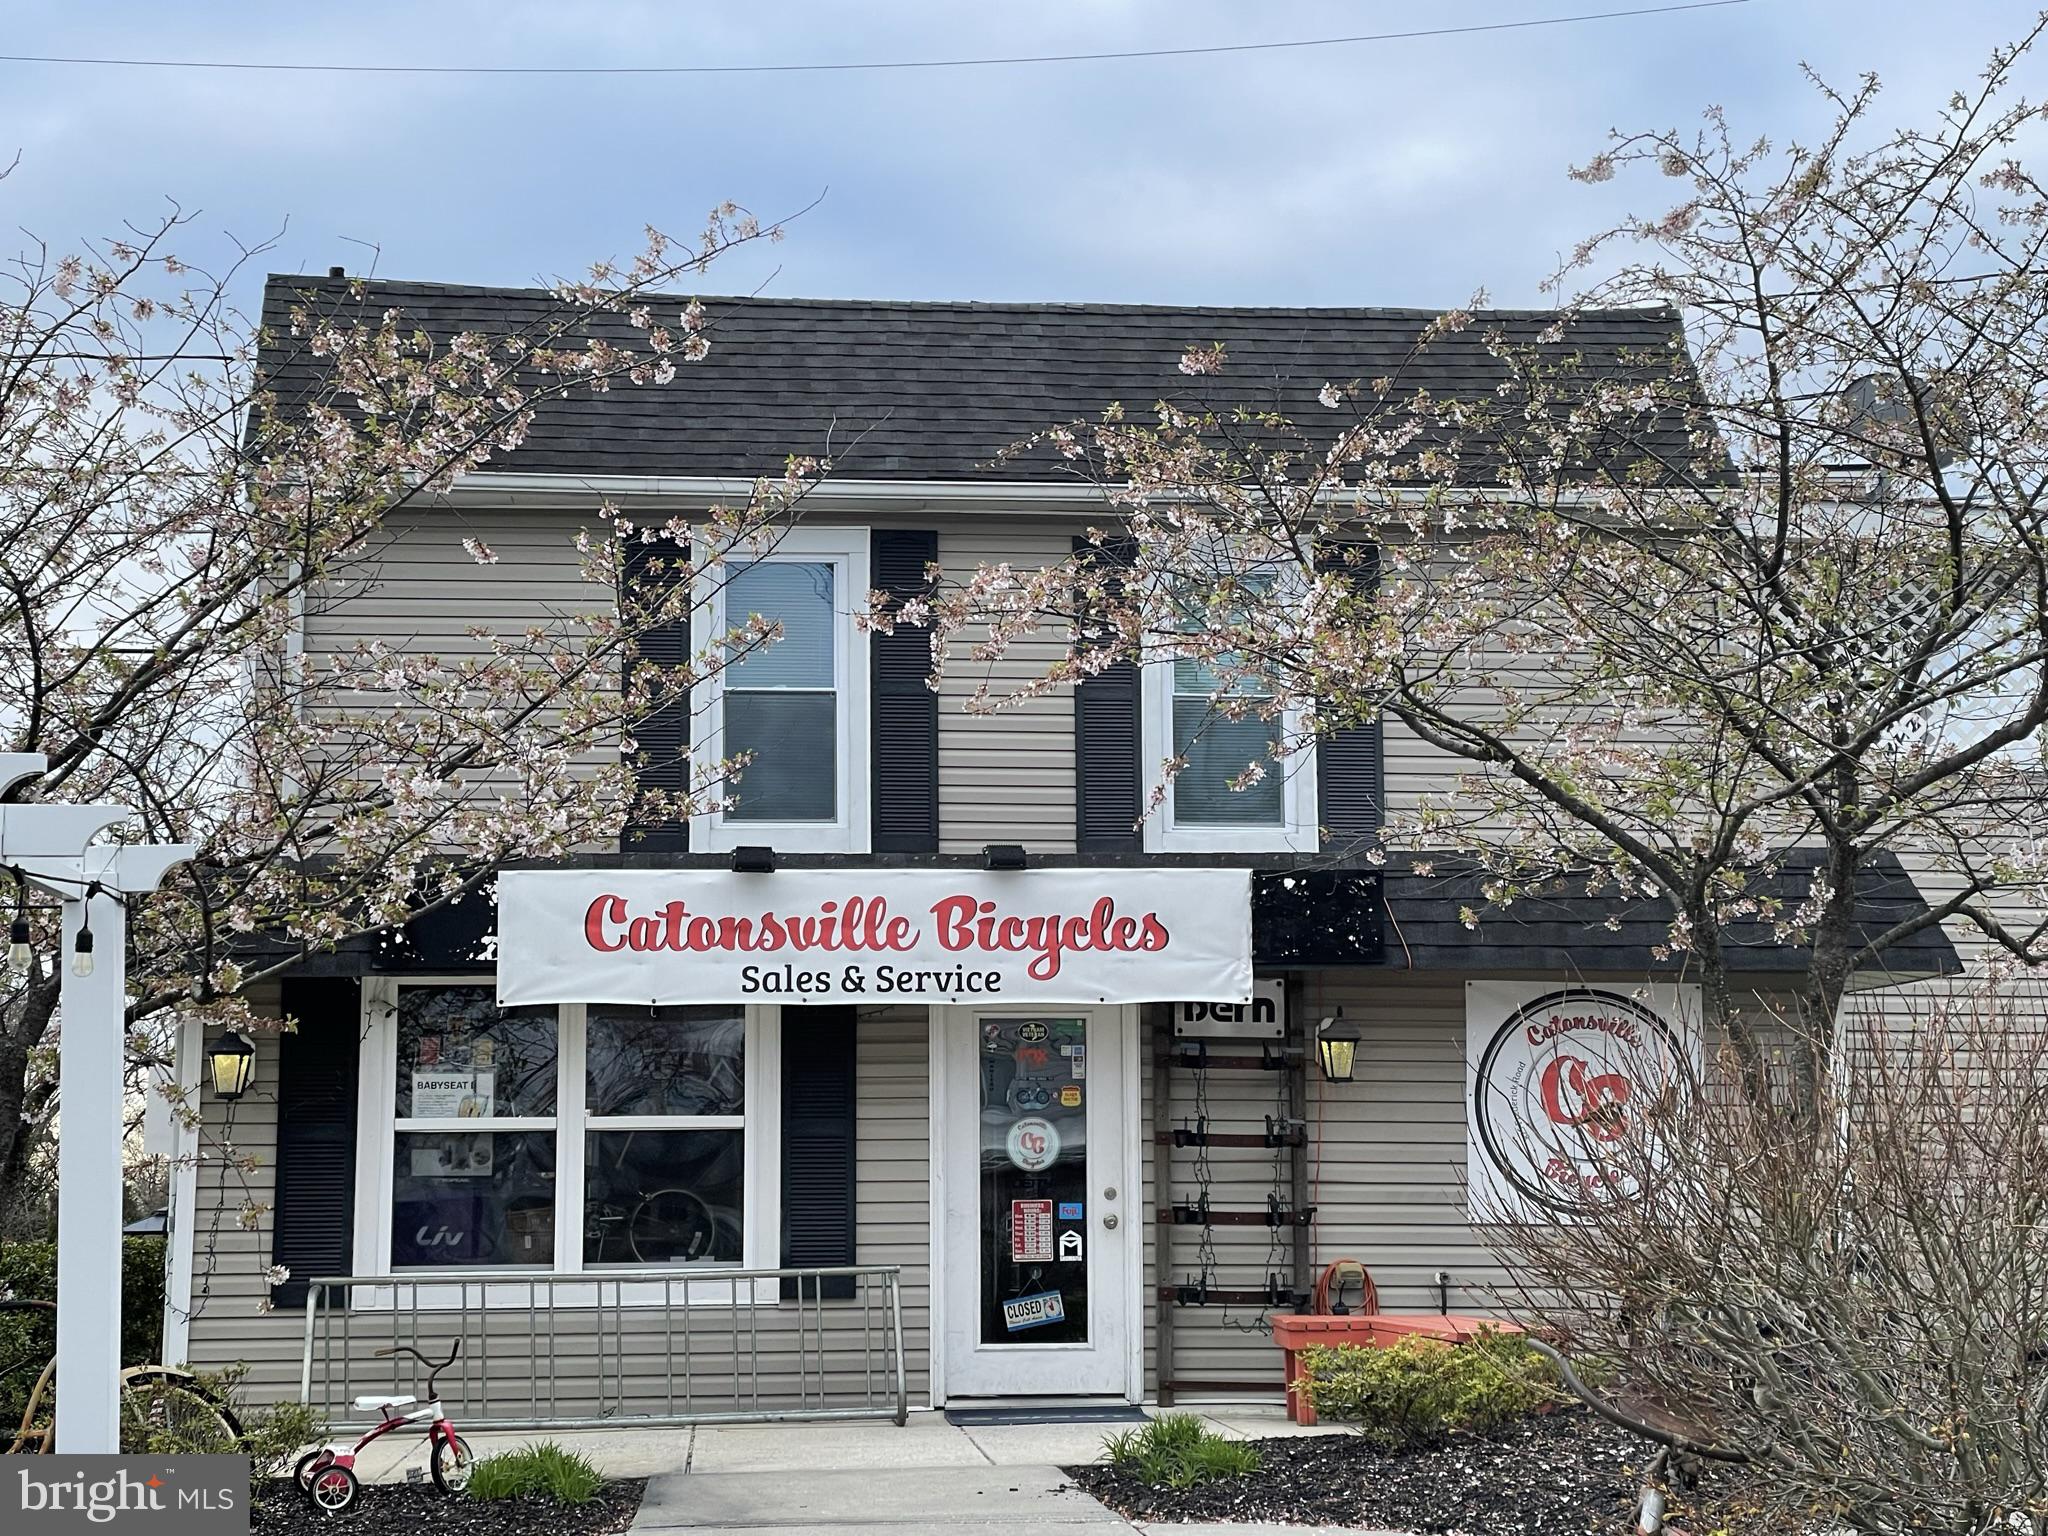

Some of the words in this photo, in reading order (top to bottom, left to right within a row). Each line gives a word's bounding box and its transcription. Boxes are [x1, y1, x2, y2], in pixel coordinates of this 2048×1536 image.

[584, 895, 919, 952] Catonsville
[930, 895, 1169, 981] Bicycles
[741, 965, 830, 993] Sales
[842, 965, 866, 993] &
[876, 964, 1001, 993] Service
[417, 1081, 469, 1090] BABYSEAT
[416, 1226, 464, 1246] Liv
[1007, 1300, 1042, 1319] CLOSED
